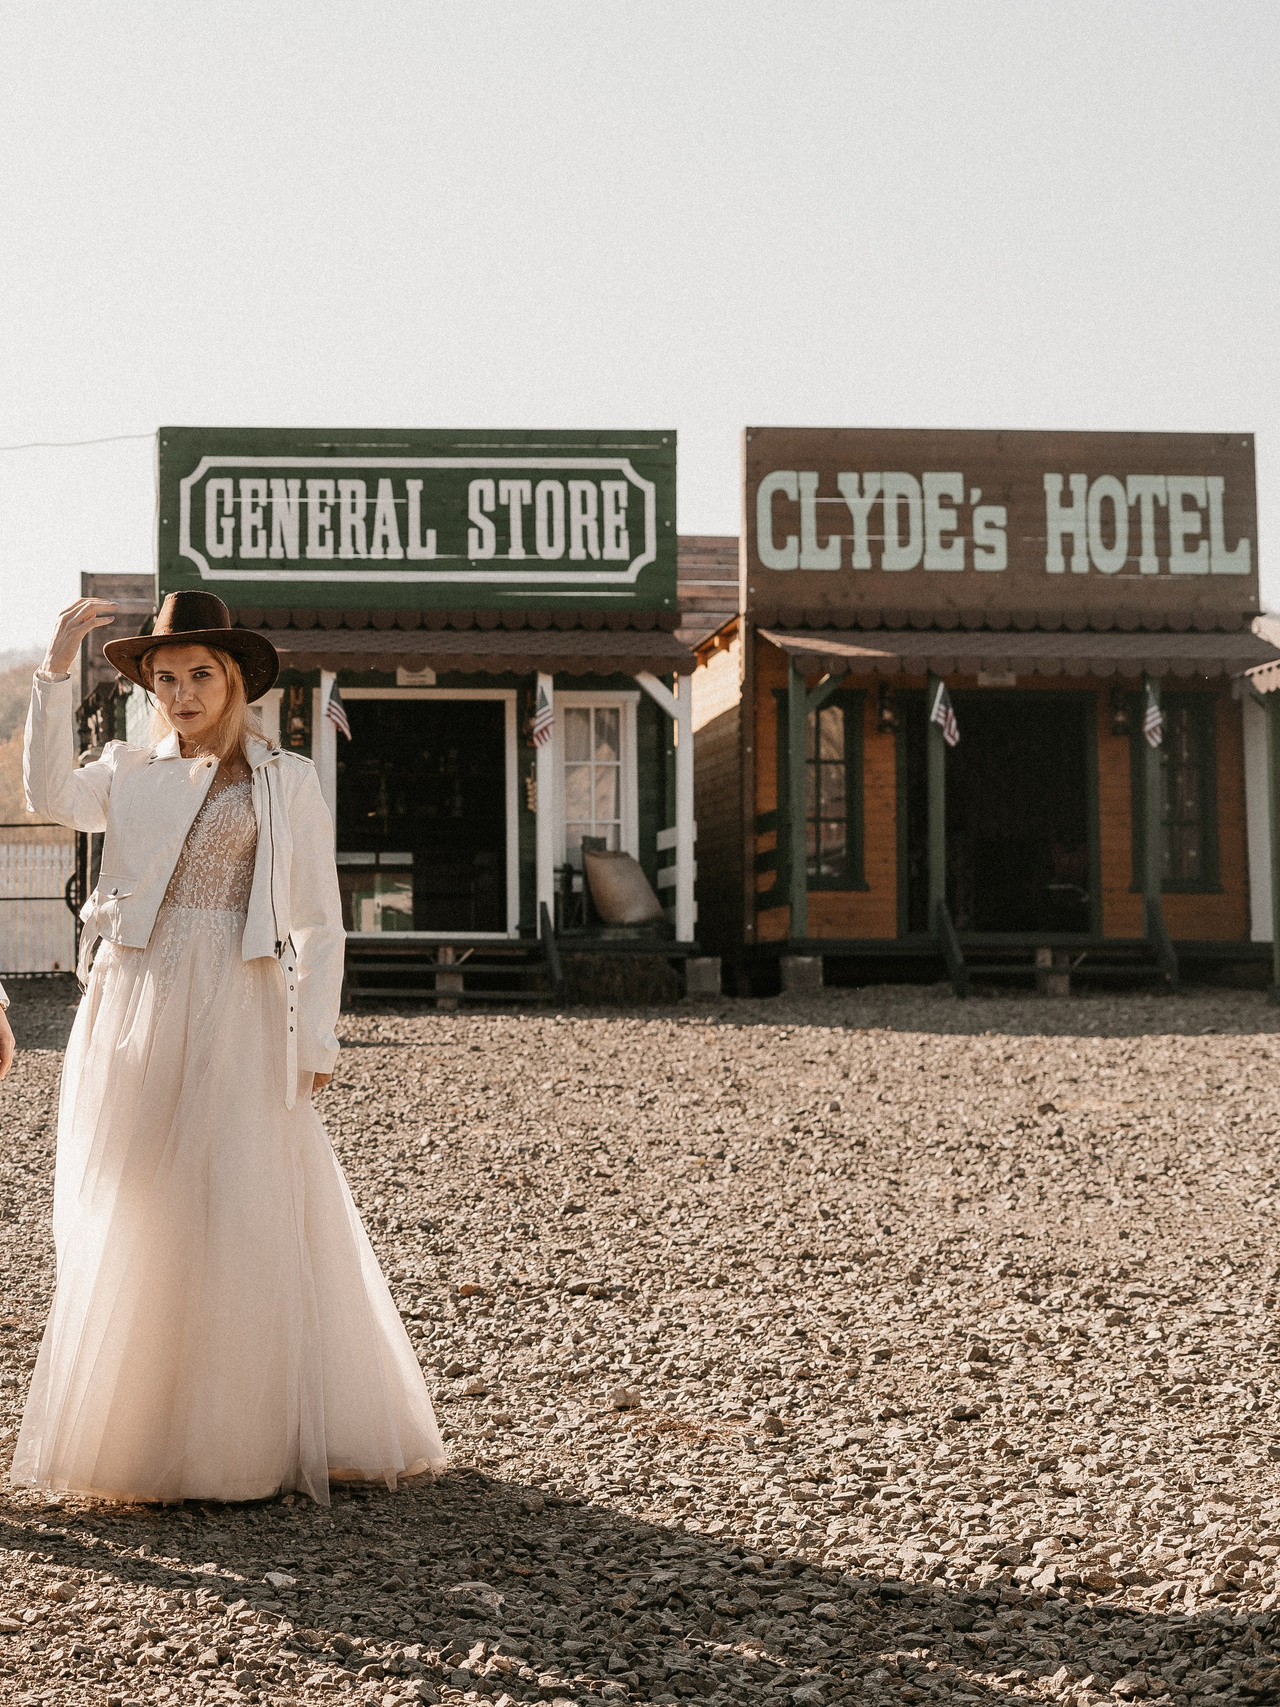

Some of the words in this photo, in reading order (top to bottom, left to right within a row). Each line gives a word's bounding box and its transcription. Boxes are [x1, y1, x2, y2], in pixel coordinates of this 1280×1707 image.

[205, 477, 437, 559] GENERAL
[467, 479, 630, 560] STORE
[756, 470, 1008, 572] CLYDE's
[1043, 473, 1252, 575] HOTEL
